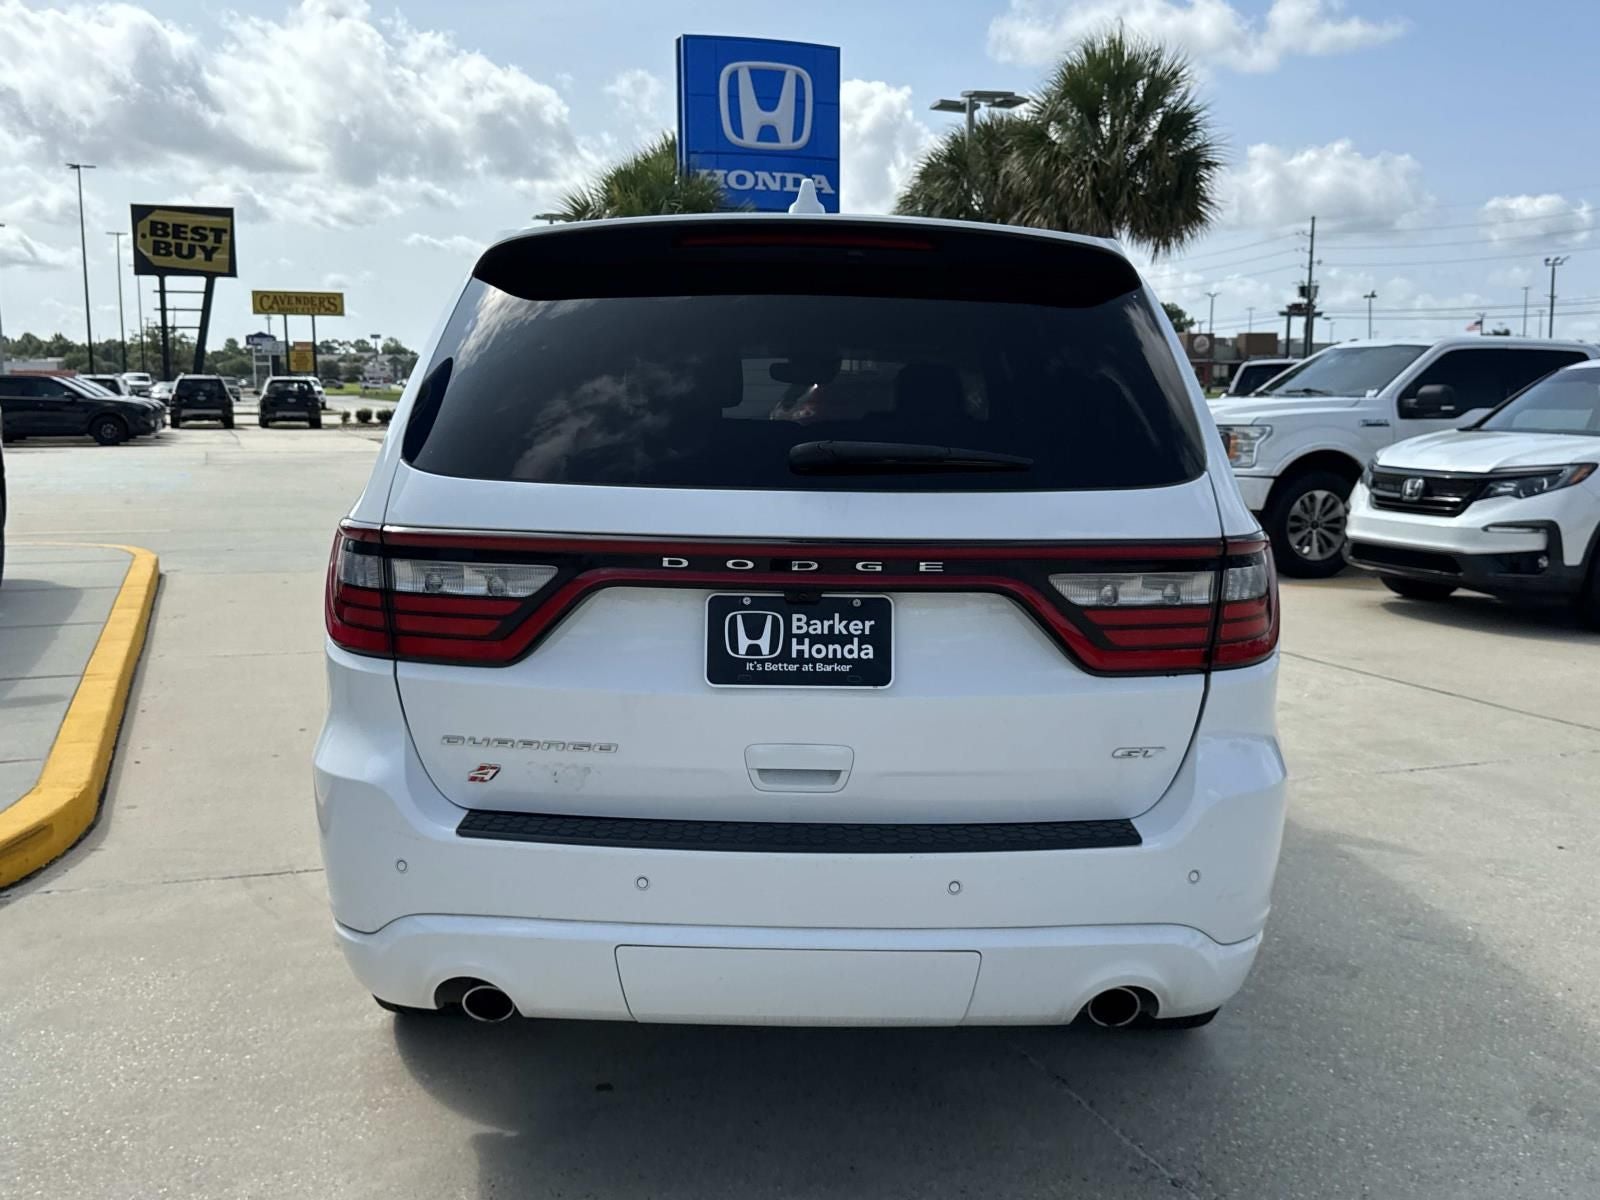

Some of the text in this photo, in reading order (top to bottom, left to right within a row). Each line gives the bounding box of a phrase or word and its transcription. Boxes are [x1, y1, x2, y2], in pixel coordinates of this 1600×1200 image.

[149, 220, 228, 244] BEST
[152, 239, 221, 262] BUY
[662, 557, 944, 572] DODGE
[791, 613, 875, 635] Barker
[791, 637, 874, 659] Honda
[746, 661, 852, 672] It's Better at Barker
[441, 735, 618, 753] DURANGO
[1111, 746, 1166, 759] GT
